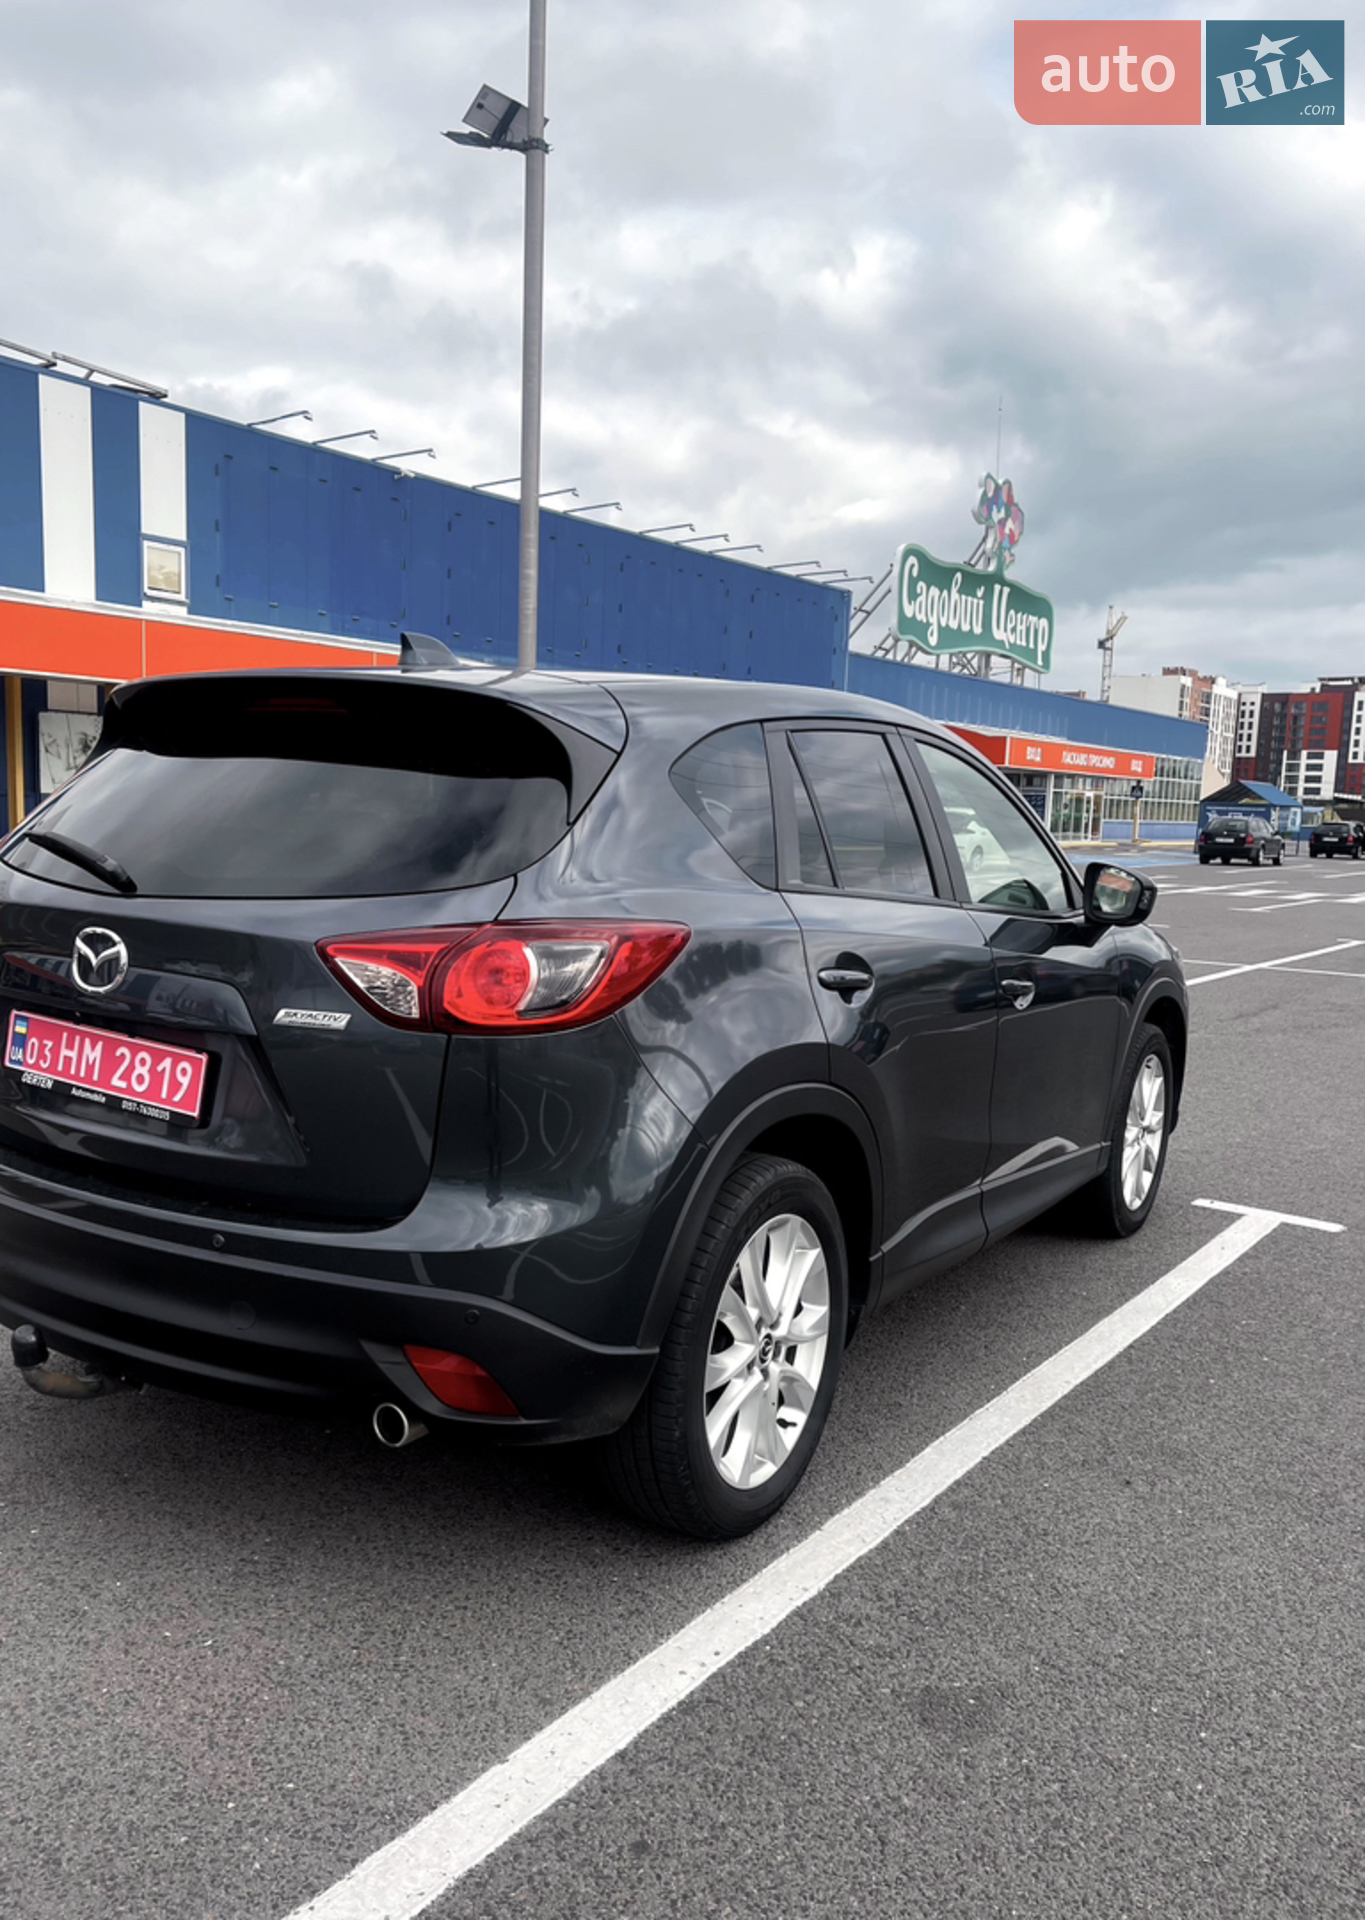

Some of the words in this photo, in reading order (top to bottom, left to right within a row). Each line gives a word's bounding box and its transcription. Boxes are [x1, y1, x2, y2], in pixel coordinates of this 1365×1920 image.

[902, 555, 985, 647] Садовий
[991, 583, 1049, 666] Центр
[10, 1046, 24, 1062] UA
[26, 1037, 54, 1069] 03
[57, 1032, 103, 1082] HM
[110, 1046, 193, 1103] 2819
